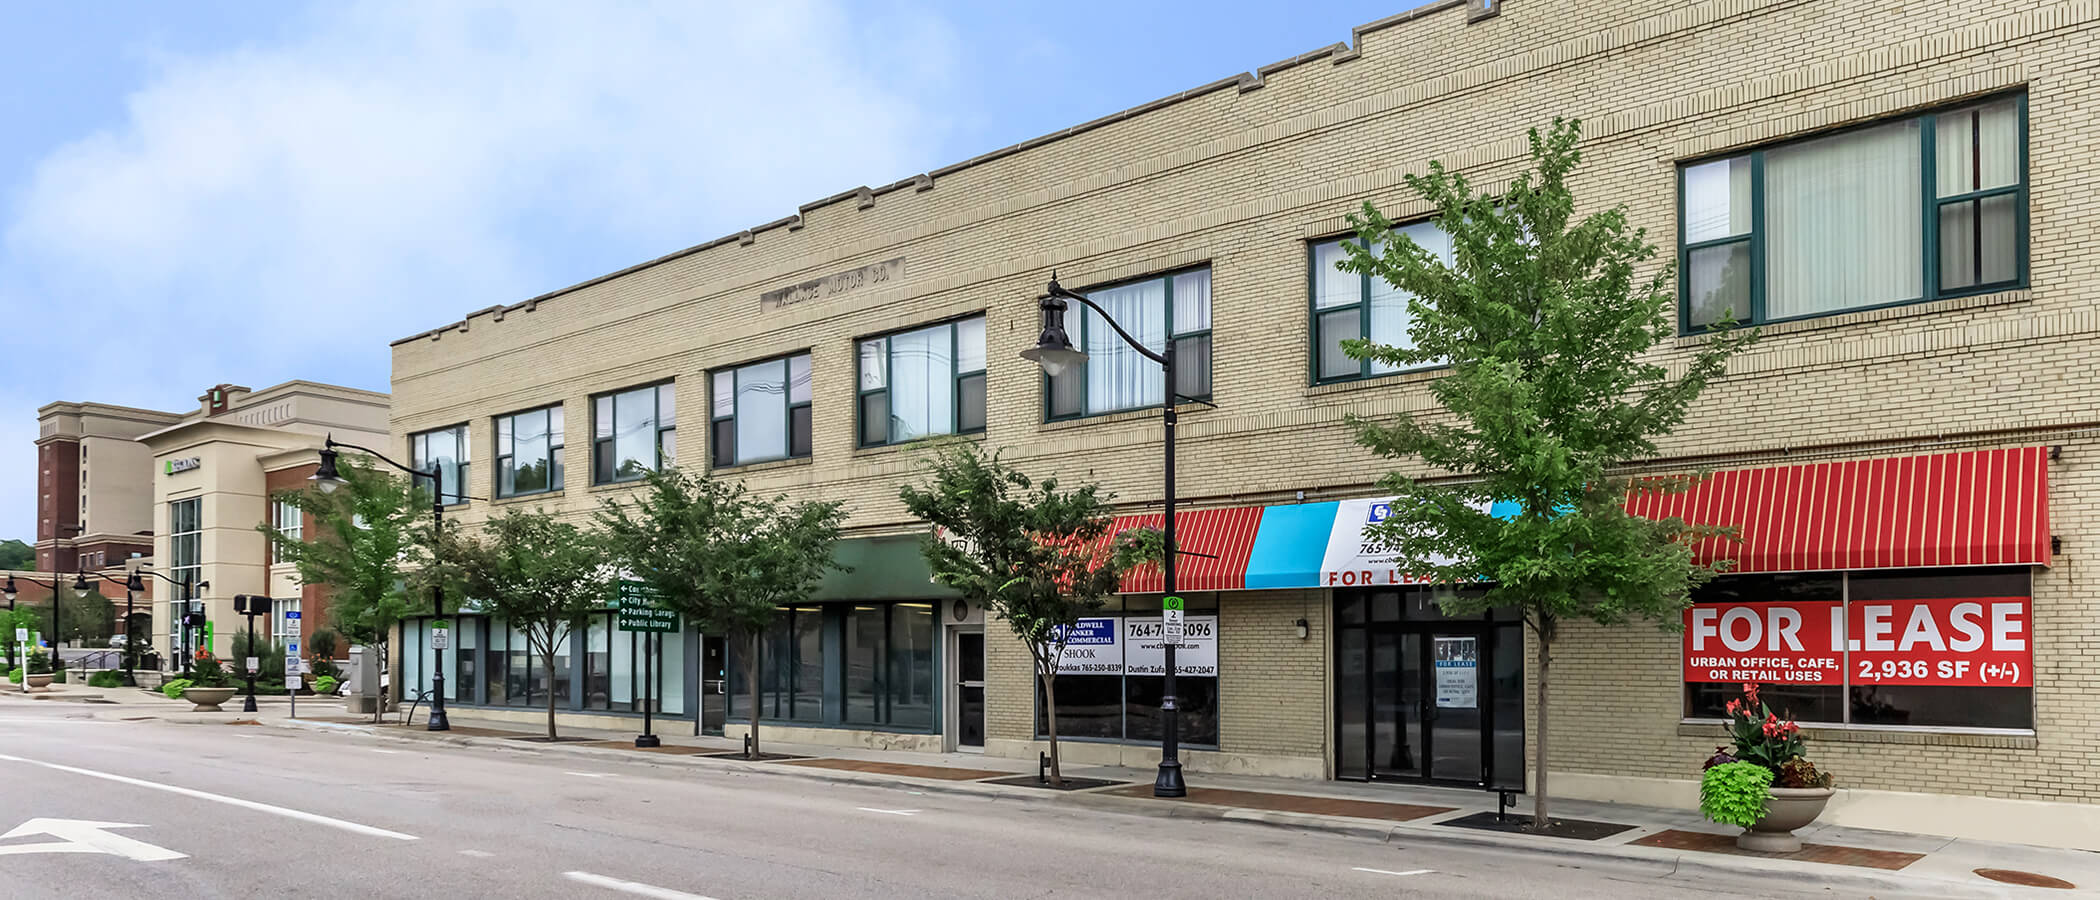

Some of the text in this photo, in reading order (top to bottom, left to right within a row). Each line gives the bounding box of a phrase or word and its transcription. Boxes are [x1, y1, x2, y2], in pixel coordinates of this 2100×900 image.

[828, 271, 864, 295] MOTOR
[1329, 571, 1373, 586] FOR
[628, 596, 641, 606] City
[628, 608, 653, 618] Parking
[1170, 610, 1177, 619] 2
[628, 619, 671, 630] Public Library
[1692, 602, 2027, 653] FOR LEASE
[1066, 636, 1113, 644] COMMERCIAL
[1064, 648, 1097, 659] SHOOK
[1128, 665, 1149, 673] Dustin
[1174, 665, 1215, 674] 65-427-2047
[1690, 657, 1840, 671] URBAN OFFICE, CAFE,
[1709, 670, 1823, 682] OR RETAIL USES
[1858, 660, 2021, 684] 2,936 SF (+/-)
